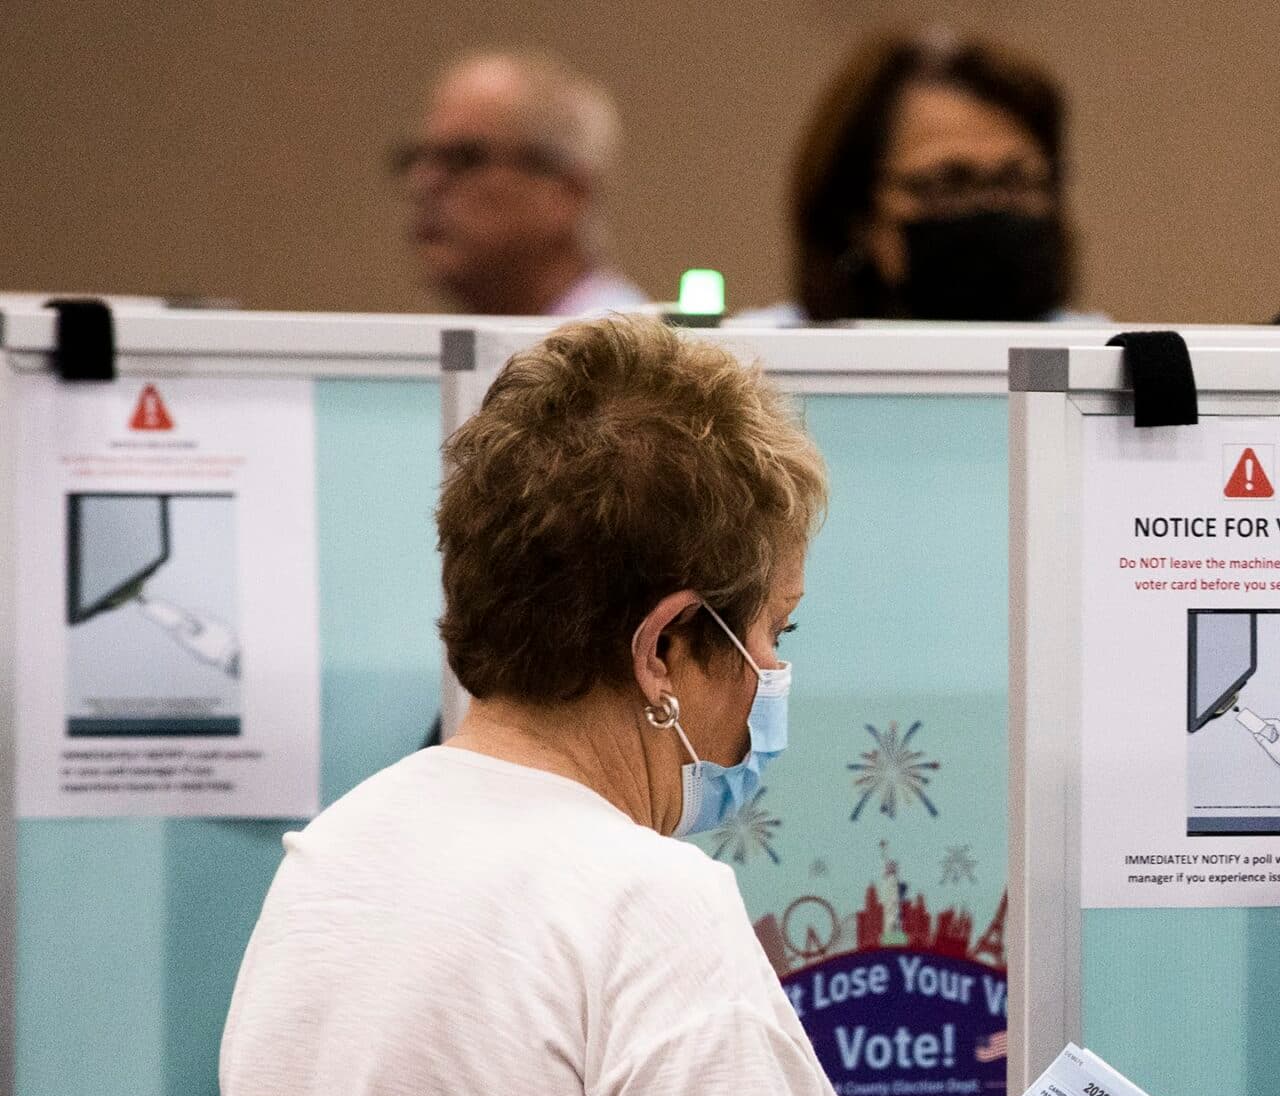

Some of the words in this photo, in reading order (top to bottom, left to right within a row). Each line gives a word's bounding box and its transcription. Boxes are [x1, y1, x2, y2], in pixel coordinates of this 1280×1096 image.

[1134, 517, 1217, 537] NOTICE
[1225, 517, 1269, 537] FOR
[1119, 557, 1136, 569] Do
[1140, 557, 1166, 569] NOT
[1170, 557, 1202, 569] leave
[1206, 557, 1226, 569] the
[1229, 557, 1280, 569] machine
[1135, 580, 1168, 590] voter
[1171, 579, 1197, 590] card
[1200, 578, 1241, 590] before
[1244, 580, 1266, 592] you
[1125, 854, 1199, 865] IMMEDIATELY
[1201, 854, 1241, 865] NOTIFY
[1243, 856, 1250, 864] a
[1252, 854, 1273, 866] poll
[1128, 874, 1174, 885] manager
[1176, 872, 1184, 883] if
[1186, 874, 1206, 885] you
[1208, 872, 1266, 885] experience
[813, 964, 890, 1010] Lose
[898, 955, 975, 1004] Your
[835, 1023, 956, 1071] Vote!
